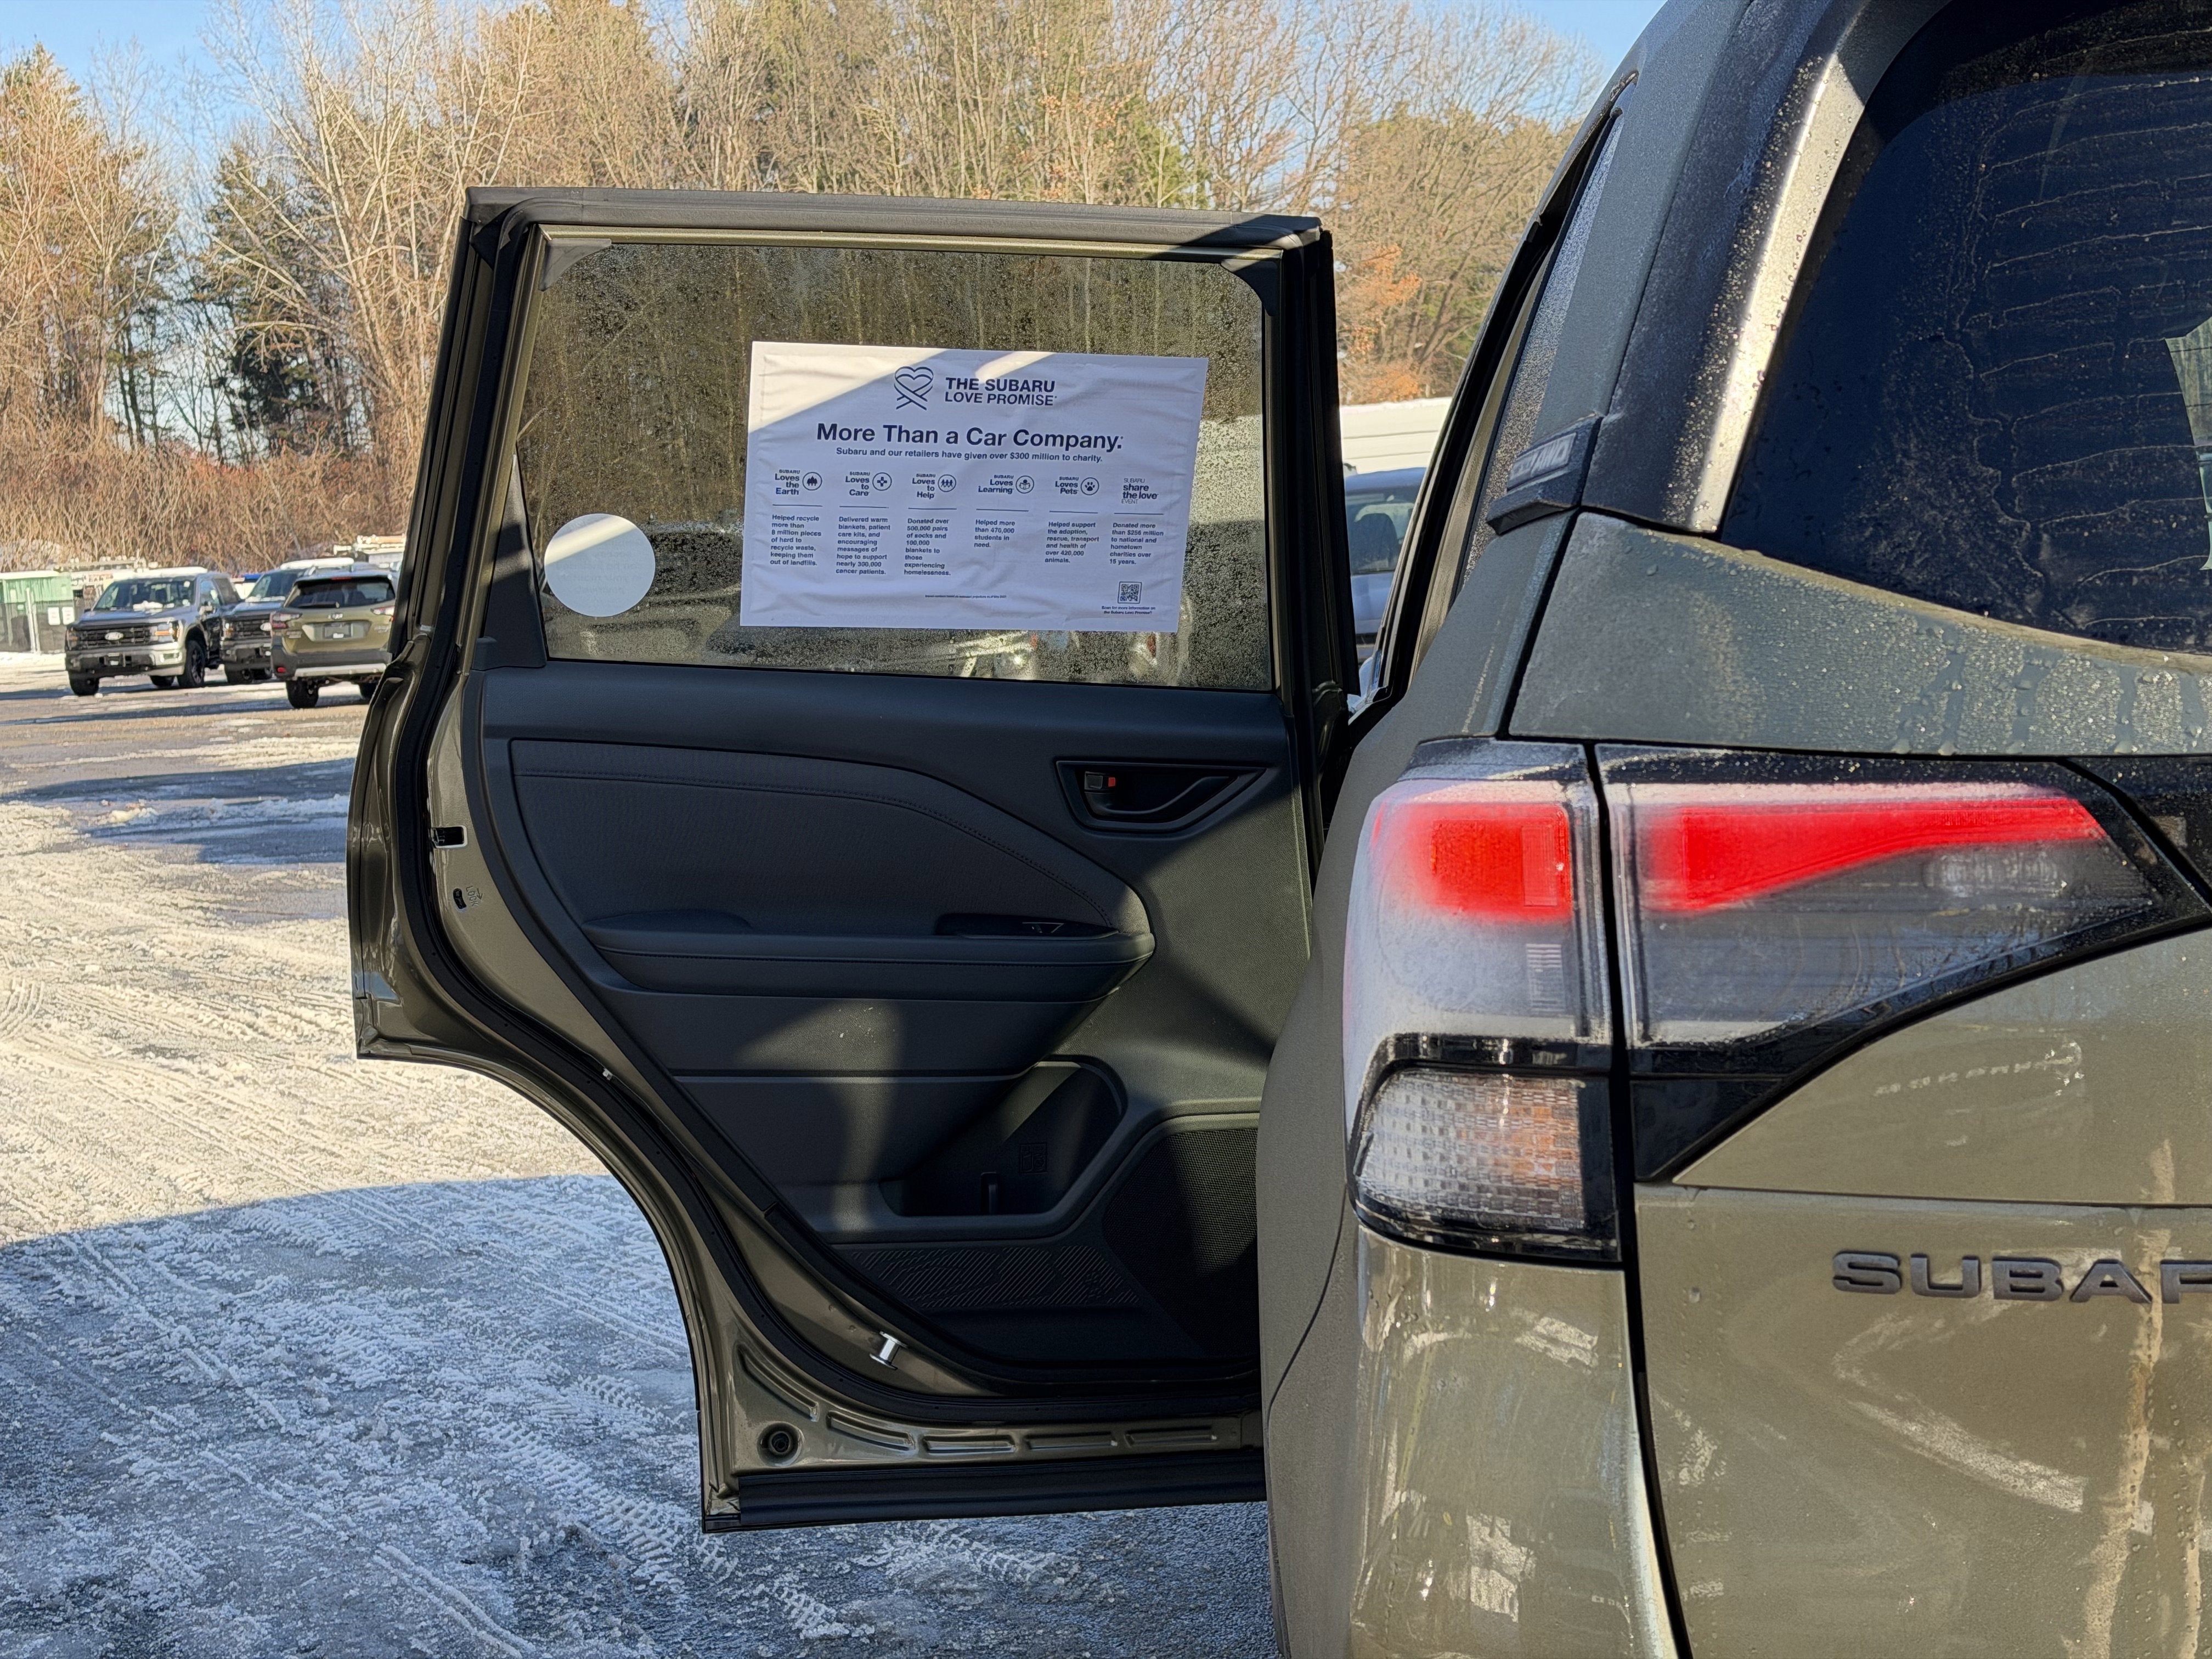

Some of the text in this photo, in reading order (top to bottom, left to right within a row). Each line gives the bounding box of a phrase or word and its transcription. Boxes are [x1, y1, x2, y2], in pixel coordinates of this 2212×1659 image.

[946, 377, 1055, 392] THE SUBARU
[945, 392, 983, 403] LOVE
[817, 424, 875, 441] More
[883, 425, 938, 443] Than
[946, 431, 958, 444] a
[967, 427, 1007, 445] Car
[964, 452, 987, 460] given
[1073, 454, 1102, 463] charity.
[978, 486, 1013, 494] Learning
[1124, 483, 1149, 492] share
[1139, 491, 1157, 499] love
[466, 885, 479, 906] LOCK
